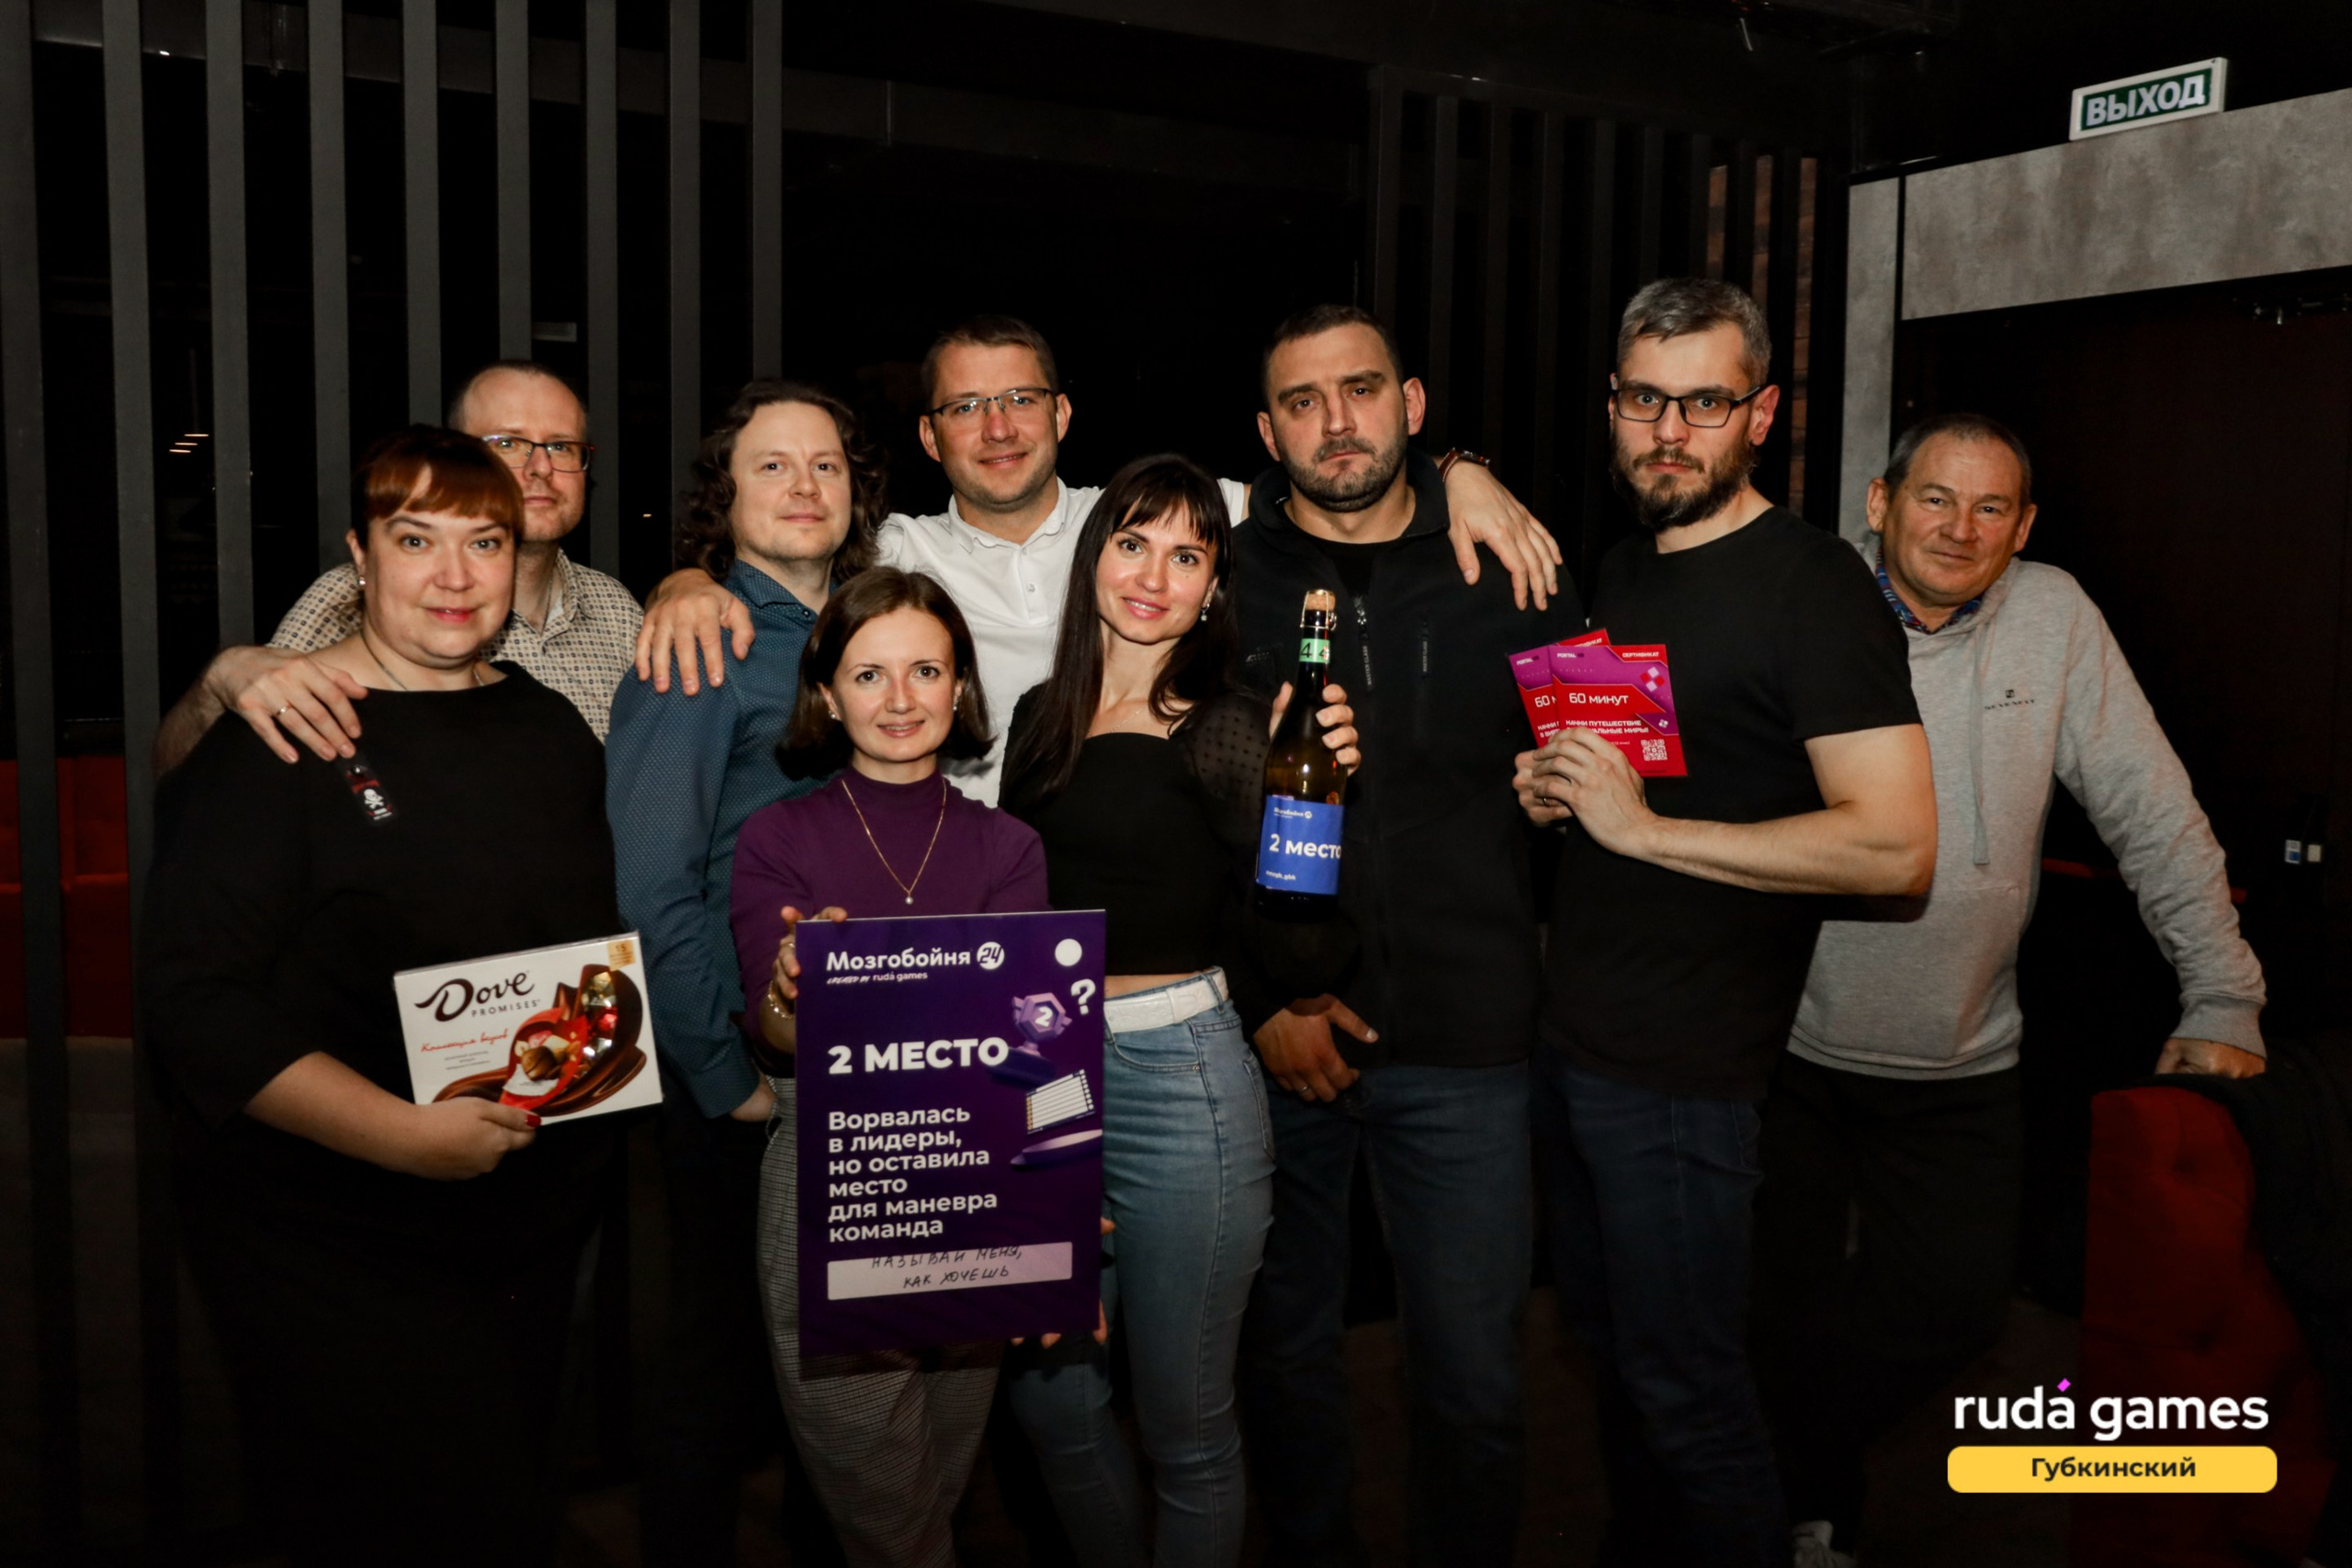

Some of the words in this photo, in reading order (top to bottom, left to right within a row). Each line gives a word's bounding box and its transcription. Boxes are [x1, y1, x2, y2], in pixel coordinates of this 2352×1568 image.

[2086, 74, 2205, 127] ВЫХОД
[1362, 645, 1370, 662] CLASS
[1364, 663, 1373, 686] MASTER
[1534, 694, 1551, 707] 60
[1568, 693, 1587, 704] 60
[1589, 719, 1642, 728] ПУТЕШЕСТВИЕ
[1269, 833, 1281, 852] 2
[1285, 840, 1341, 860] место
[826, 947, 971, 972] Мозгобойня
[978, 944, 1003, 965] 24
[896, 971, 928, 982] games
[413, 972, 536, 1022] Dove
[470, 999, 538, 1017] PROMISES
[1035, 1007, 1054, 1027] 2
[828, 1044, 854, 1075] 2
[864, 1036, 1010, 1073] МЕСТО
[828, 1107, 971, 1133] Ворвалась
[828, 1137, 843, 1153] в
[850, 1130, 963, 1153] лидеры,
[828, 1157, 865, 1176] но
[868, 1149, 990, 1173] оставила
[828, 1178, 909, 1198] место
[828, 1201, 877, 1224] для
[885, 1193, 998, 1214] маневра
[829, 1219, 944, 1243] команда
[902, 1273, 932, 1289] КАК
[939, 1265, 1010, 1285] ХОЧЕШЬ
